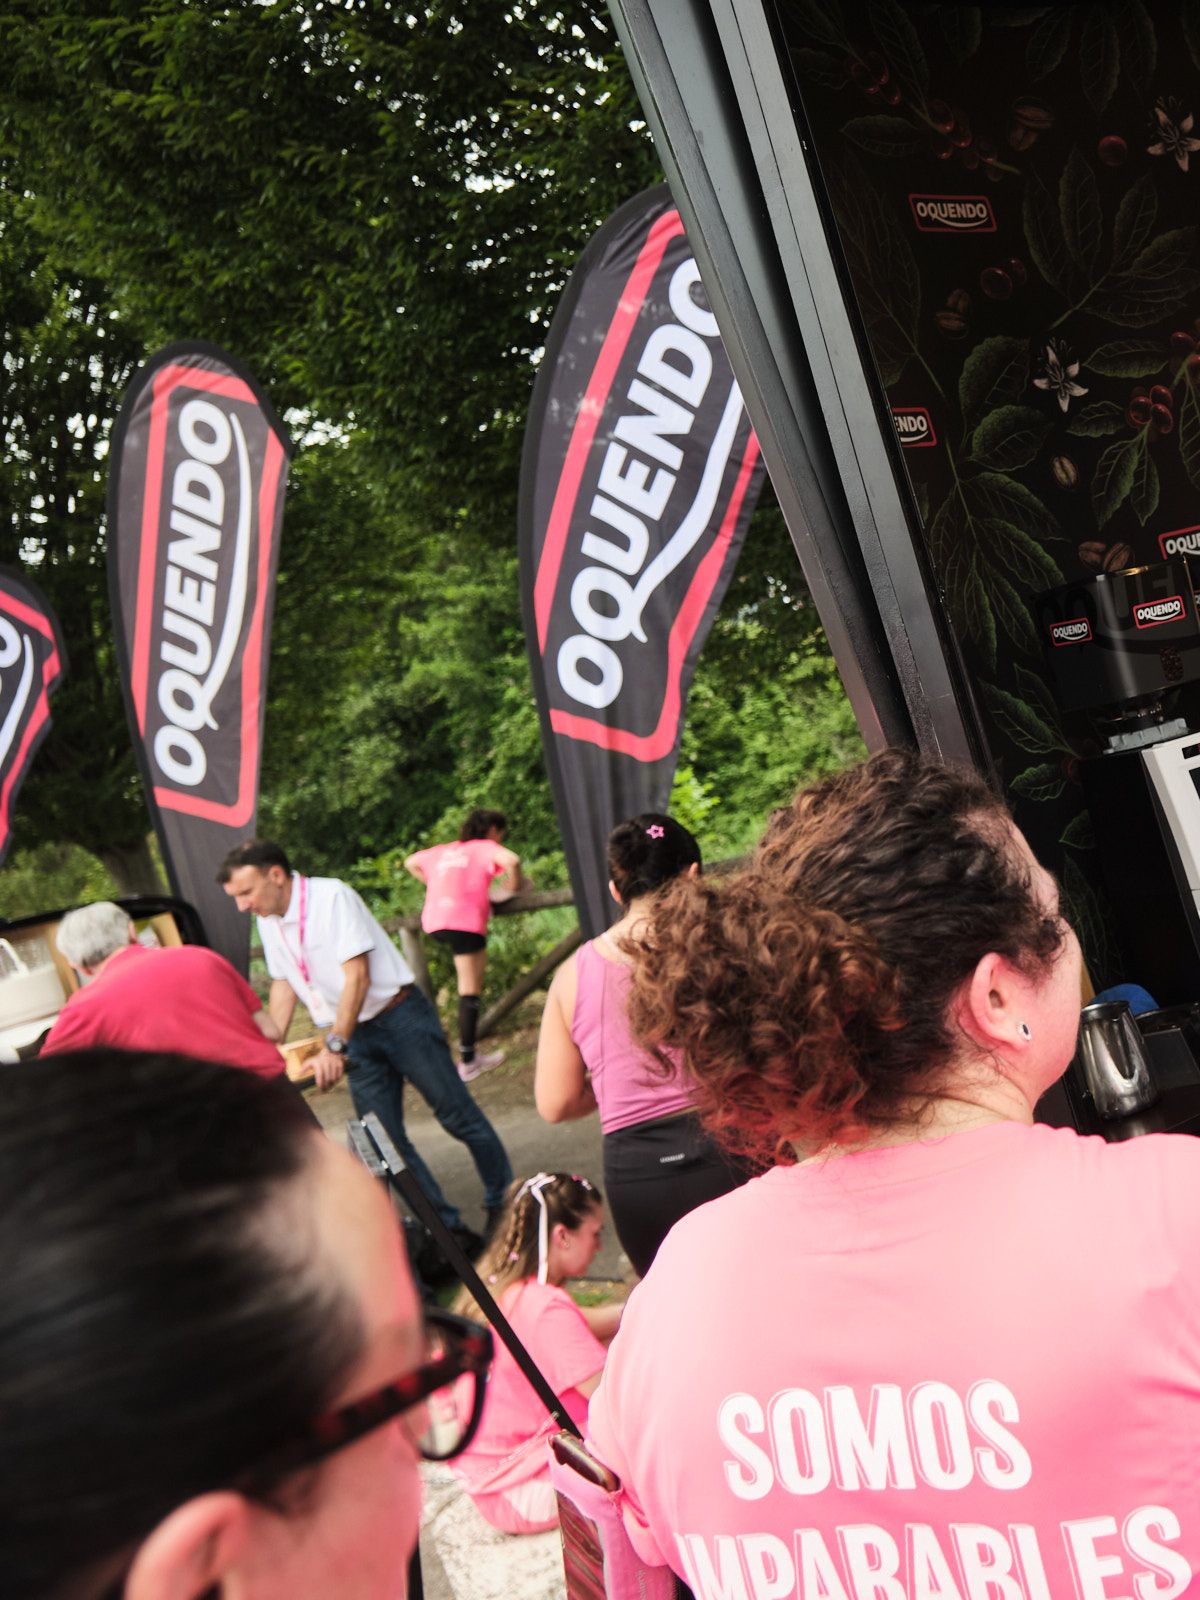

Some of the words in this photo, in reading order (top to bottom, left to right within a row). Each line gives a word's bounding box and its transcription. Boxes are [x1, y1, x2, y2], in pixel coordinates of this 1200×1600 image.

[916, 202, 988, 227] OQUENDO
[557, 257, 740, 709] OQUENDO
[153, 399, 252, 786] OQUENDO
[1053, 623, 1088, 640] OQUENDO
[1137, 601, 1181, 620] OQUENDO
[717, 1378, 1032, 1500] SOMOS
[673, 1505, 1192, 1600] IMPARABLES
